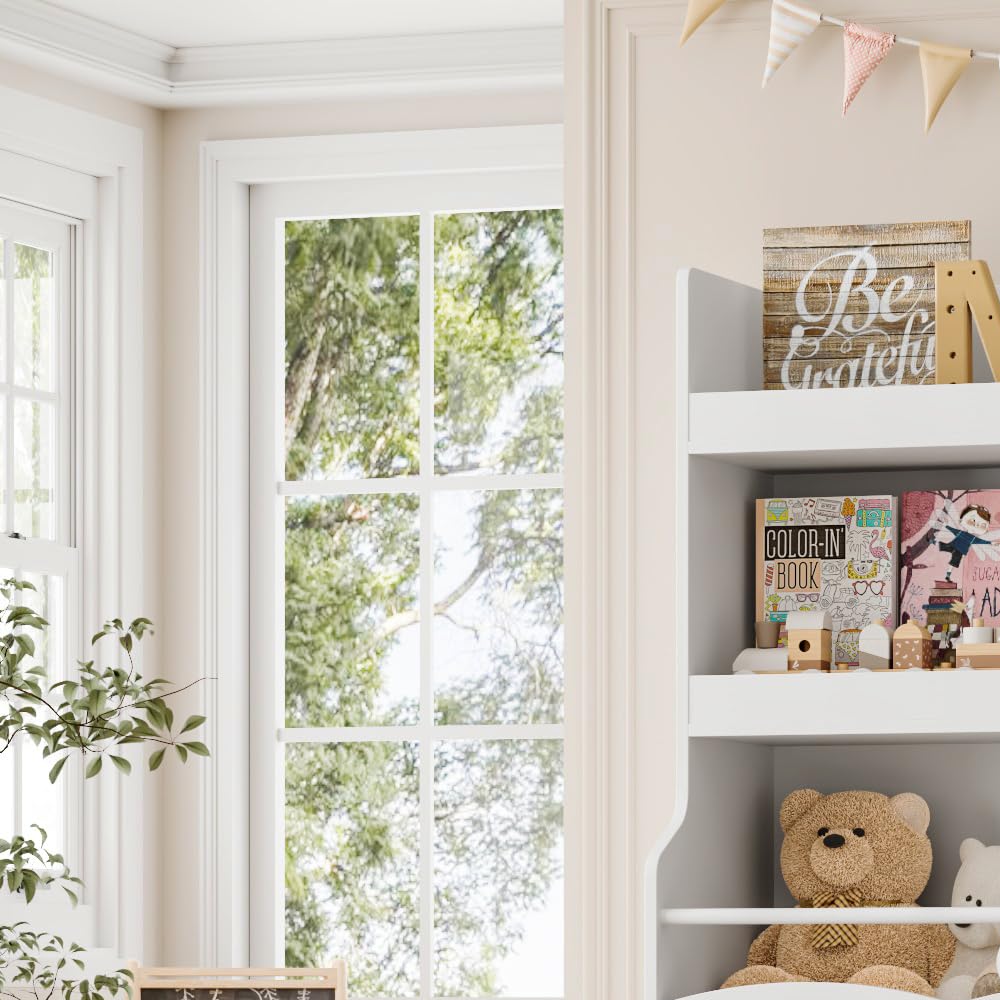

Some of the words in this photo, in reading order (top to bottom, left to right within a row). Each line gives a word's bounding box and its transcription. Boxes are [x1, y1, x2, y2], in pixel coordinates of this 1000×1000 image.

[796, 241, 928, 333] Be
[780, 309, 936, 390] Gratefu
[777, 561, 819, 590] BOOK
